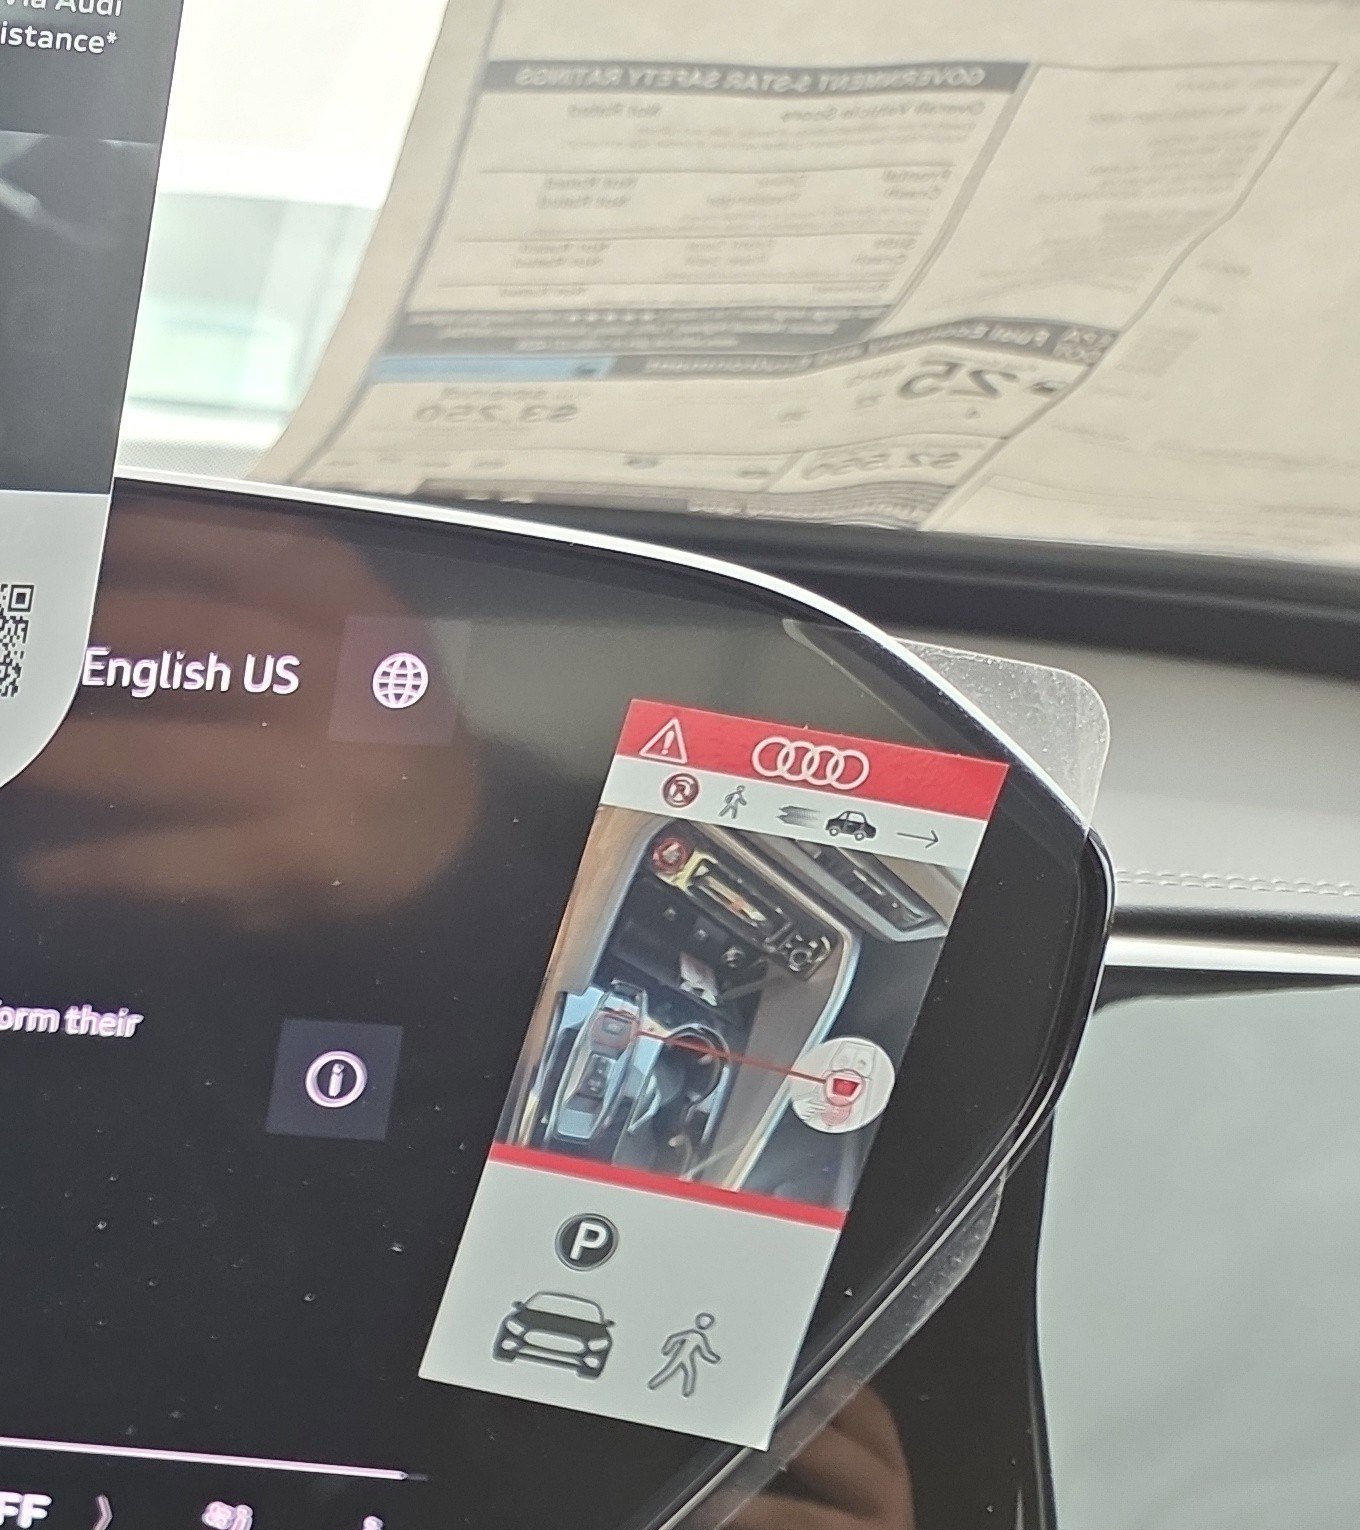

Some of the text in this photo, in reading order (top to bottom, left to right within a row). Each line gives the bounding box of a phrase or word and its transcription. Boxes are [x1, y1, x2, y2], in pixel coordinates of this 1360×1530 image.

[81, 645, 302, 699] English US
[63, 1004, 144, 1039] their
